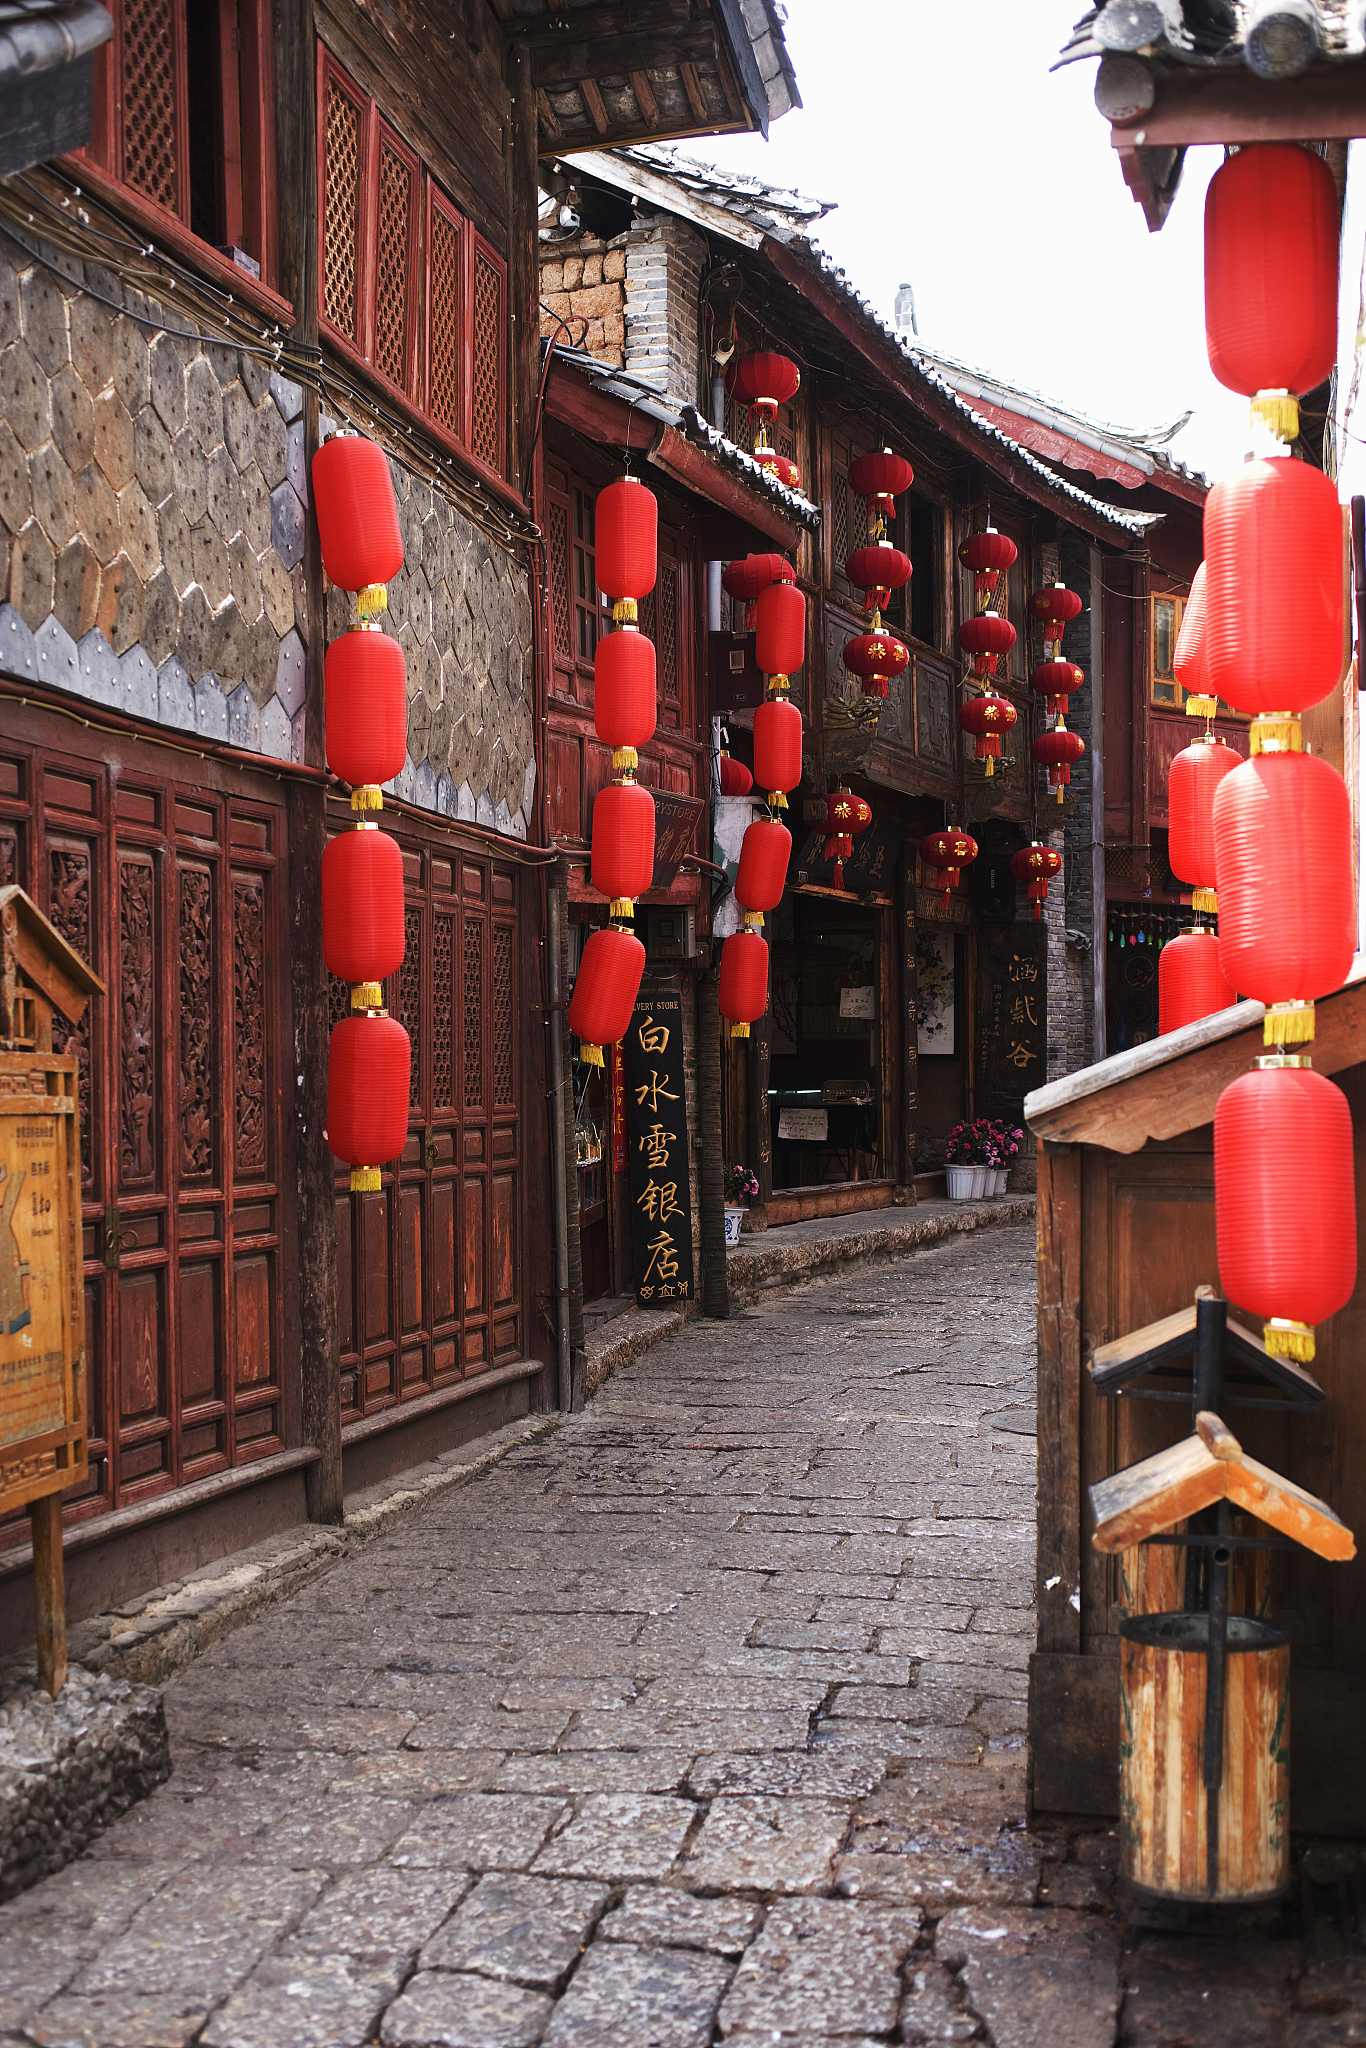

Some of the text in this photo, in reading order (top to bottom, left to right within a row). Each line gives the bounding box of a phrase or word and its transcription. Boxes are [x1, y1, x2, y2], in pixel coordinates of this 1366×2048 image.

[656, 1001, 679, 1010] STORE
[635, 1015, 686, 1283] 白水雪银店
